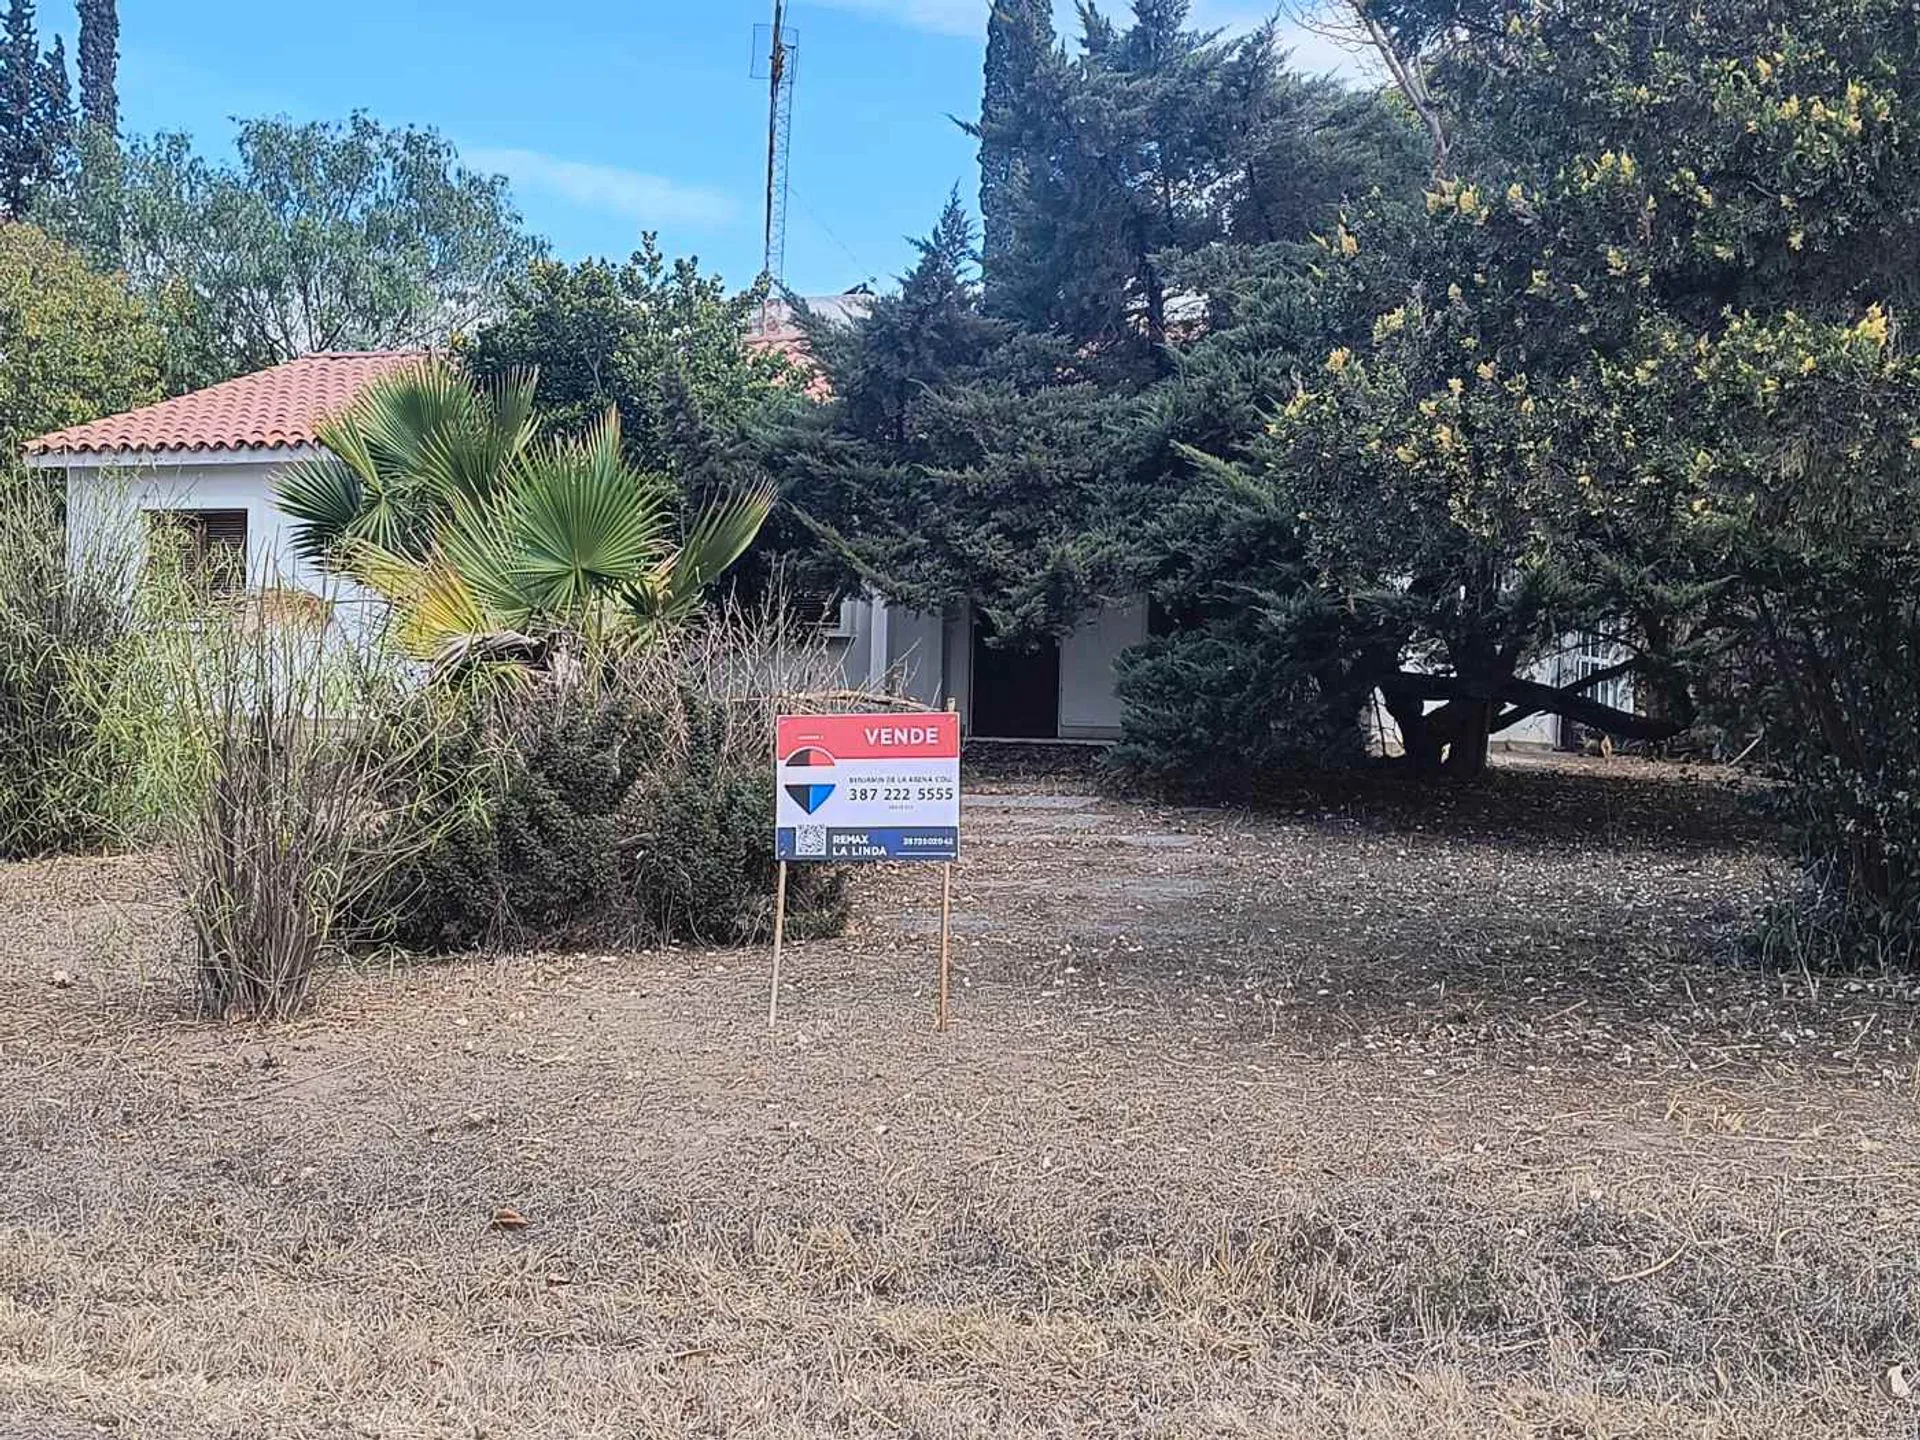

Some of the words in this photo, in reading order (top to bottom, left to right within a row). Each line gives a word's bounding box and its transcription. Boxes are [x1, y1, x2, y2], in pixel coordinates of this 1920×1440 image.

[864, 727, 939, 745] VENDE
[849, 788, 878, 801] 387
[884, 788, 911, 801] 222
[917, 787, 953, 801] 5555
[832, 835, 869, 845] REMAX
[832, 846, 847, 856] LA
[852, 846, 887, 856] LINDA
